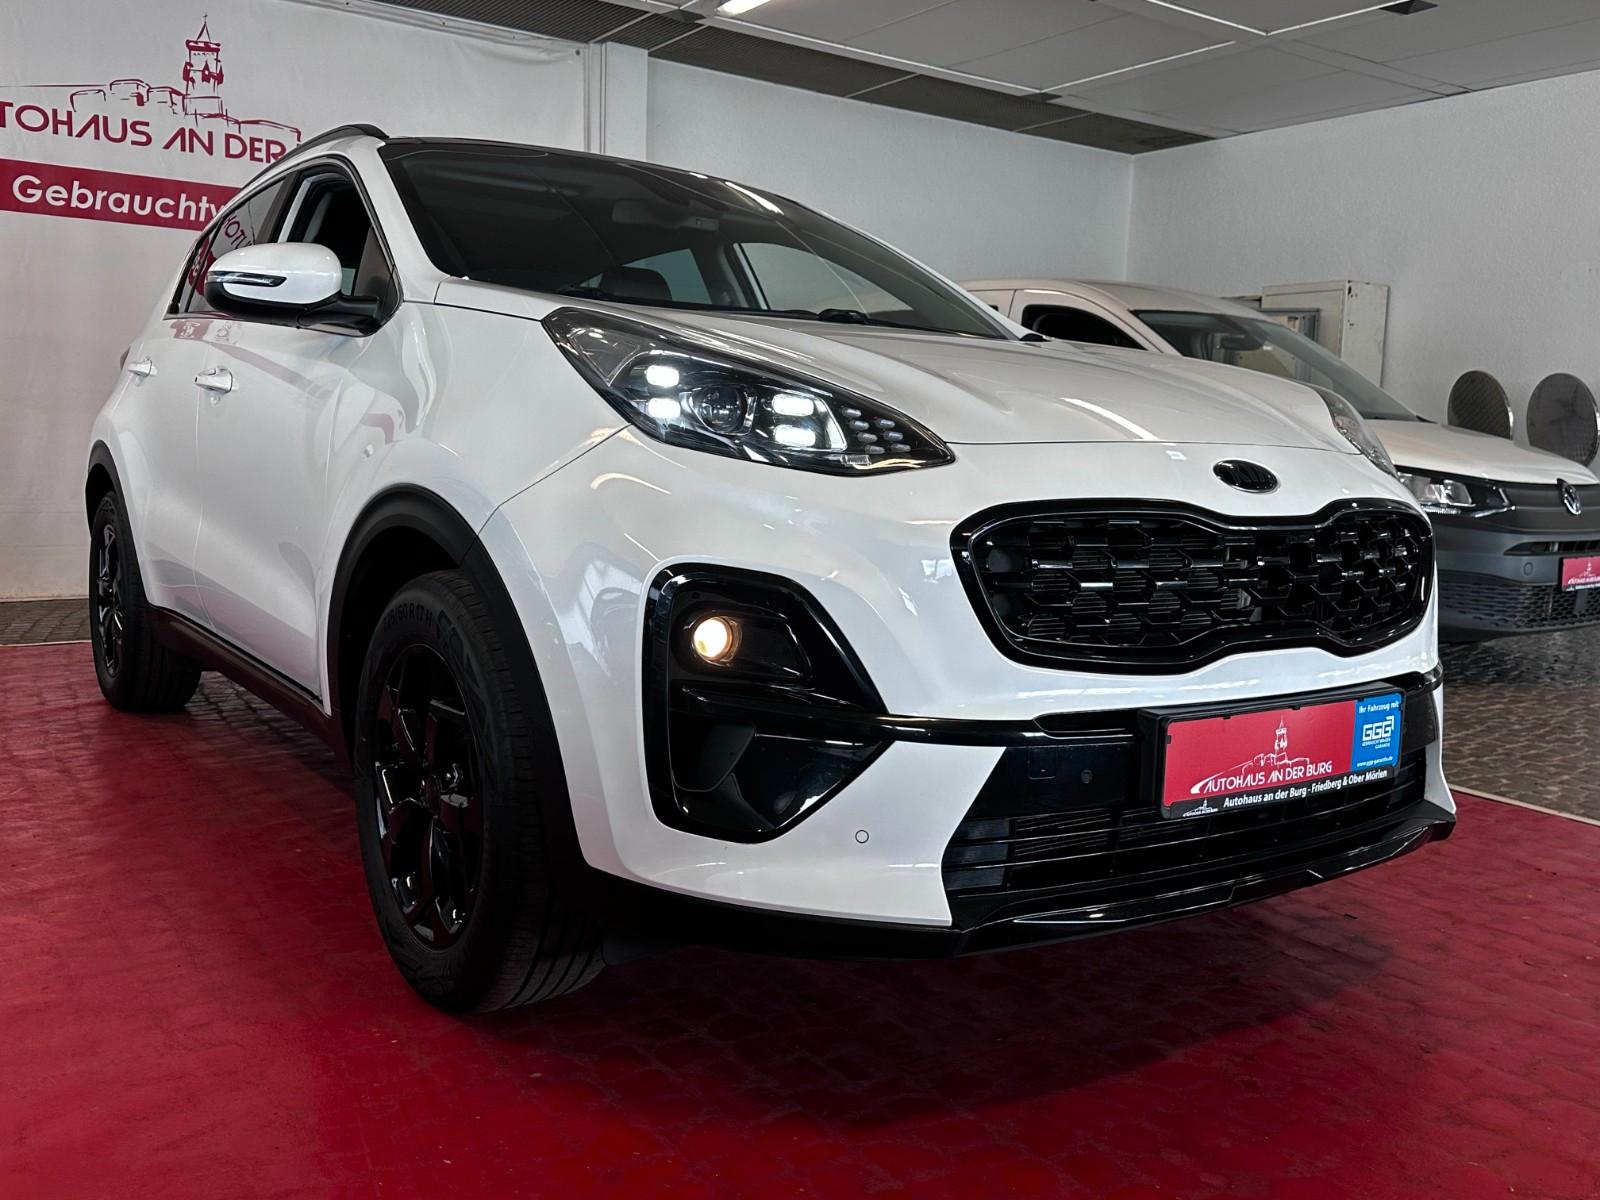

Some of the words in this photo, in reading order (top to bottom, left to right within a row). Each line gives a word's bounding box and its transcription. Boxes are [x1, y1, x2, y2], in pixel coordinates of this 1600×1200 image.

[163, 126, 214, 157] AN
[225, 133, 286, 163] DER
[1203, 771, 1265, 794] AUTOHAUS
[1268, 769, 1283, 783] AN
[1285, 765, 1304, 780] DER
[1306, 761, 1332, 777] BURG
[1223, 794, 1262, 808] Autohaus
[1263, 793, 1274, 801] an
[1275, 789, 1288, 800] der
[1289, 787, 1307, 798] Burg
[1311, 780, 1342, 793] Friedberg
[1342, 776, 1348, 786] &
[1348, 775, 1365, 785] Ober
[1365, 769, 1387, 780] Mörlen
